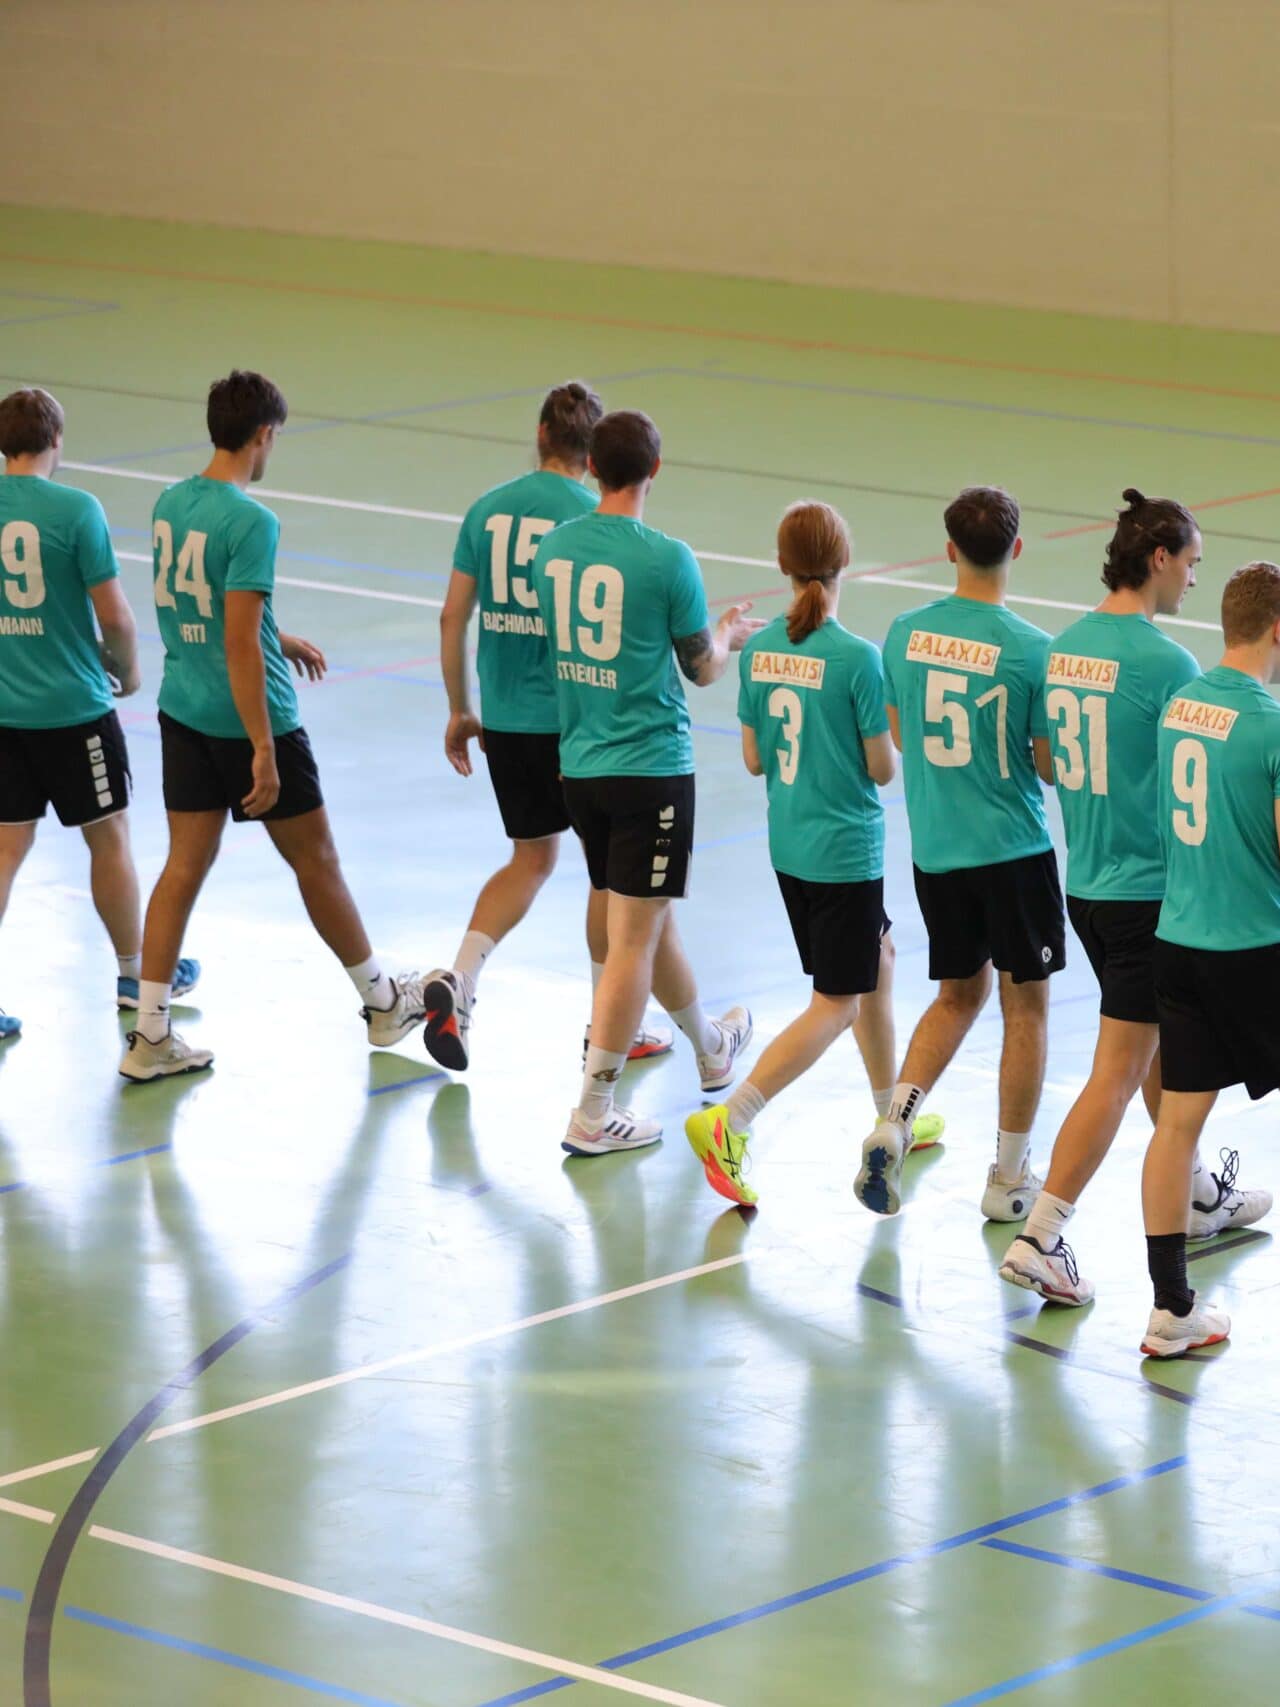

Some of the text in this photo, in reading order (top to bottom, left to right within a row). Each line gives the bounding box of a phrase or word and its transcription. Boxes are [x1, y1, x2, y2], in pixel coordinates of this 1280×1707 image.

[1, 521, 46, 609] 9
[153, 519, 213, 619] 24
[485, 514, 556, 608] 15
[544, 558, 624, 661] 19
[909, 633, 993, 666] GALAXIS
[769, 688, 802, 785] 3
[924, 669, 1010, 779] 51
[1046, 688, 1108, 795] 31
[1172, 738, 1208, 846] 9
